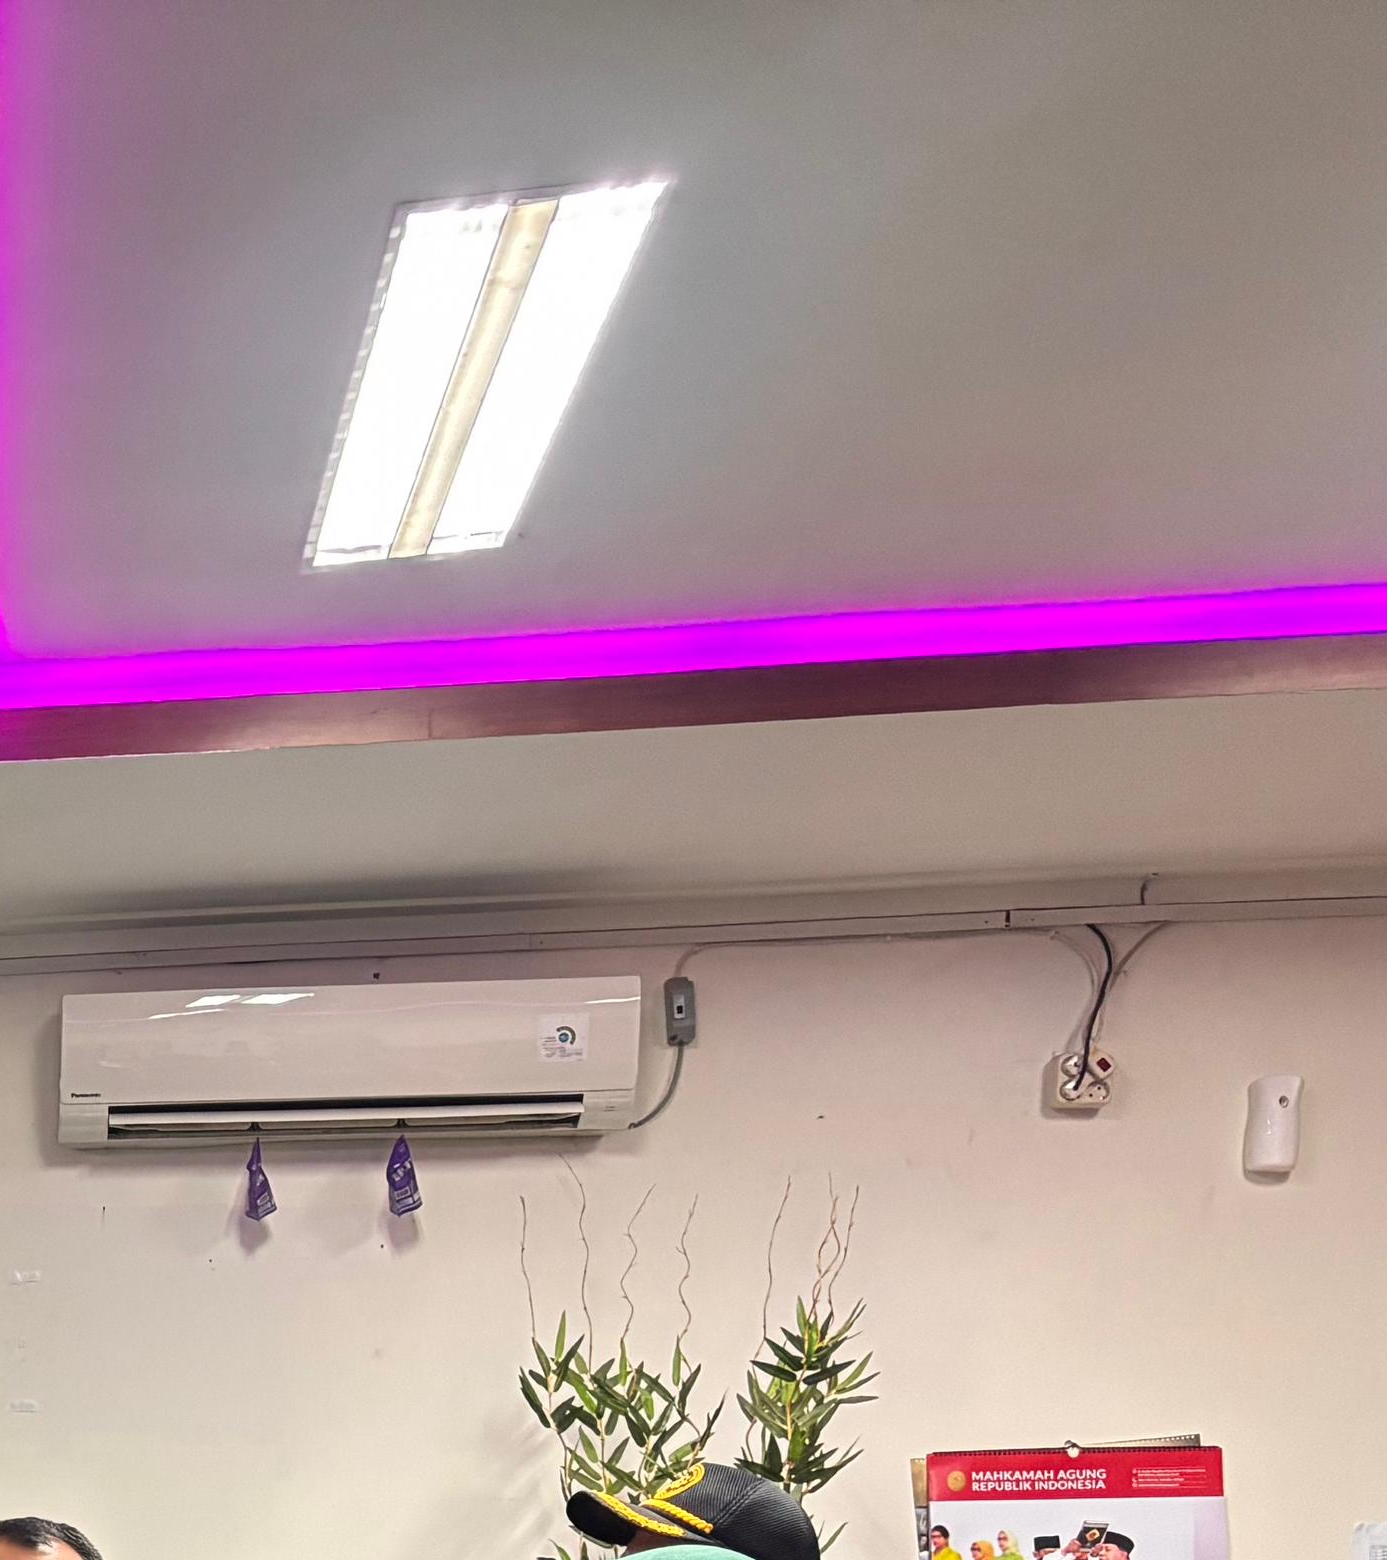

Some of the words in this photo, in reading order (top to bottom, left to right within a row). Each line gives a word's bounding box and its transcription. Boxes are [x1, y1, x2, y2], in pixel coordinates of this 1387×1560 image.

[971, 1469, 1054, 1481] MAHKAMAH
[1057, 1468, 1107, 1480] AGUNG
[971, 1480, 1033, 1492] REPUBLIK
[1034, 1480, 1107, 1490] INDONESIA
